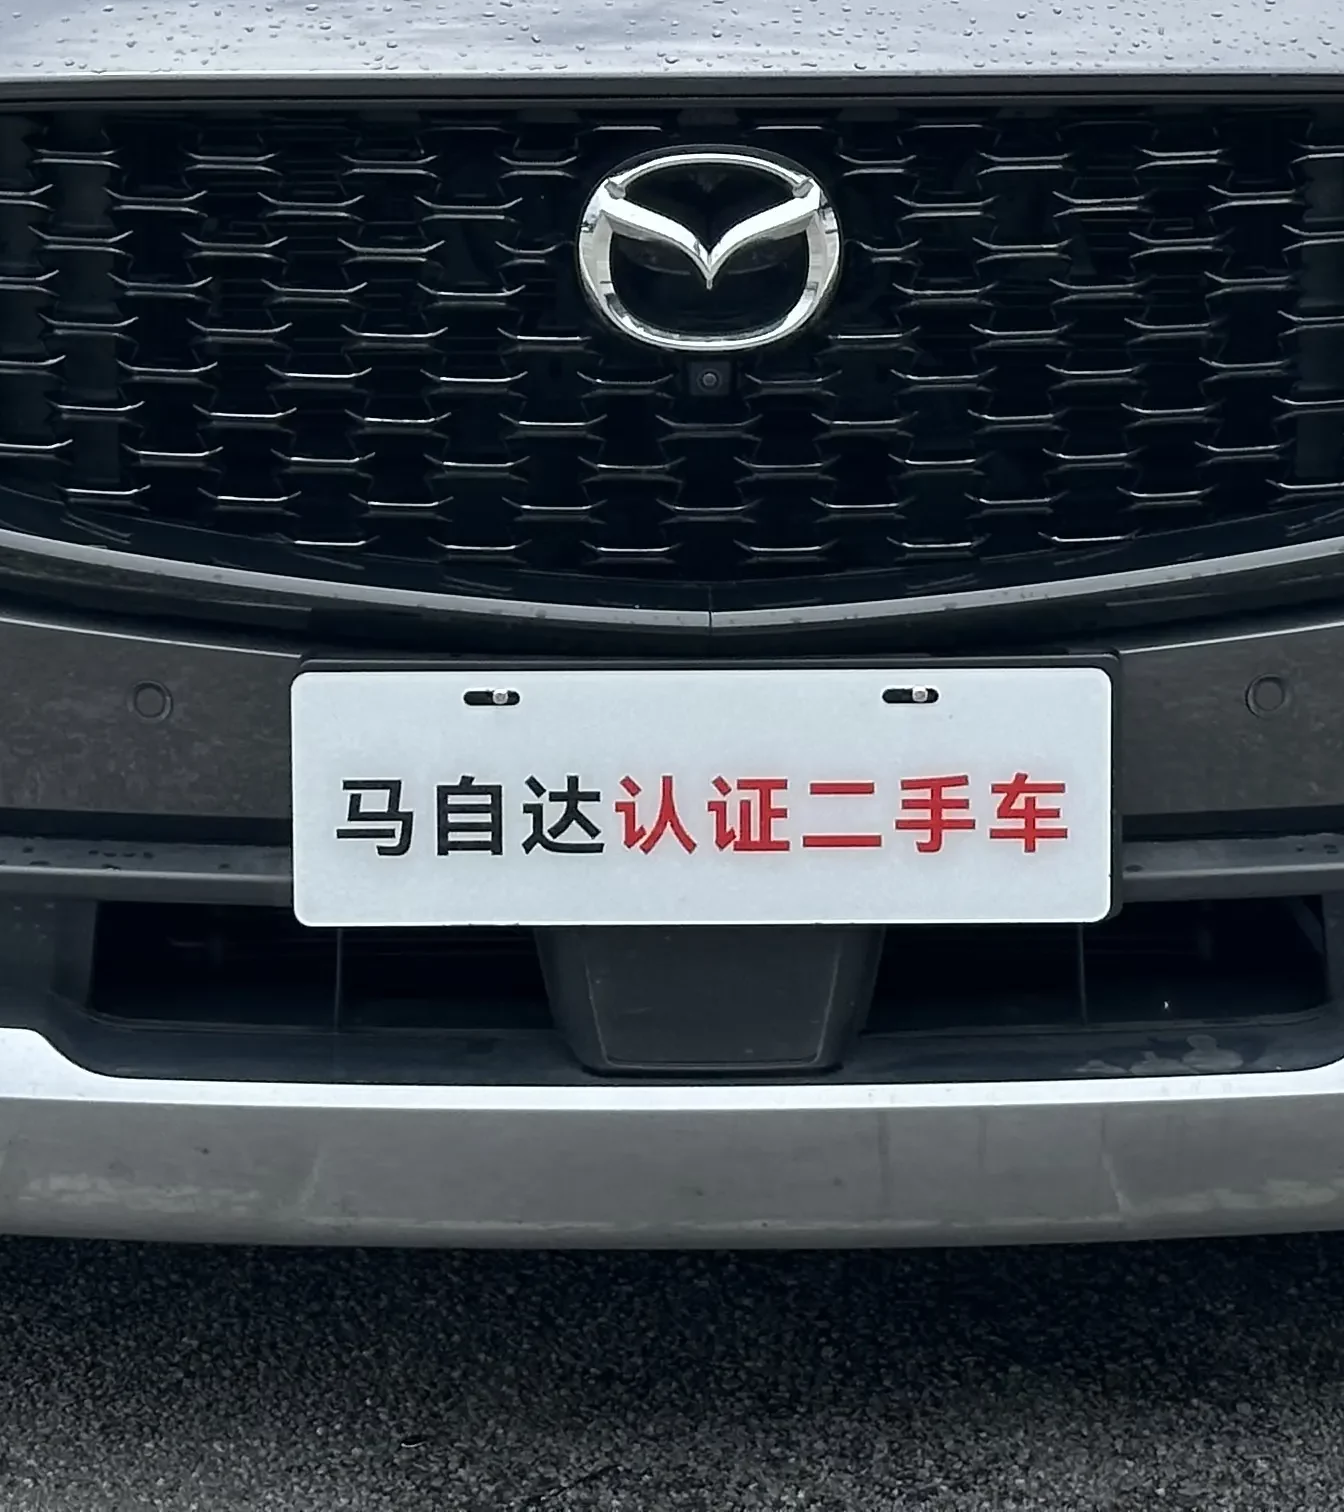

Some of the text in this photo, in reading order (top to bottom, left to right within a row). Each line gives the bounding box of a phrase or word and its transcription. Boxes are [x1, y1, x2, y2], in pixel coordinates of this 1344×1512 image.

[336, 772, 1068, 857] 马自达认证二手车
